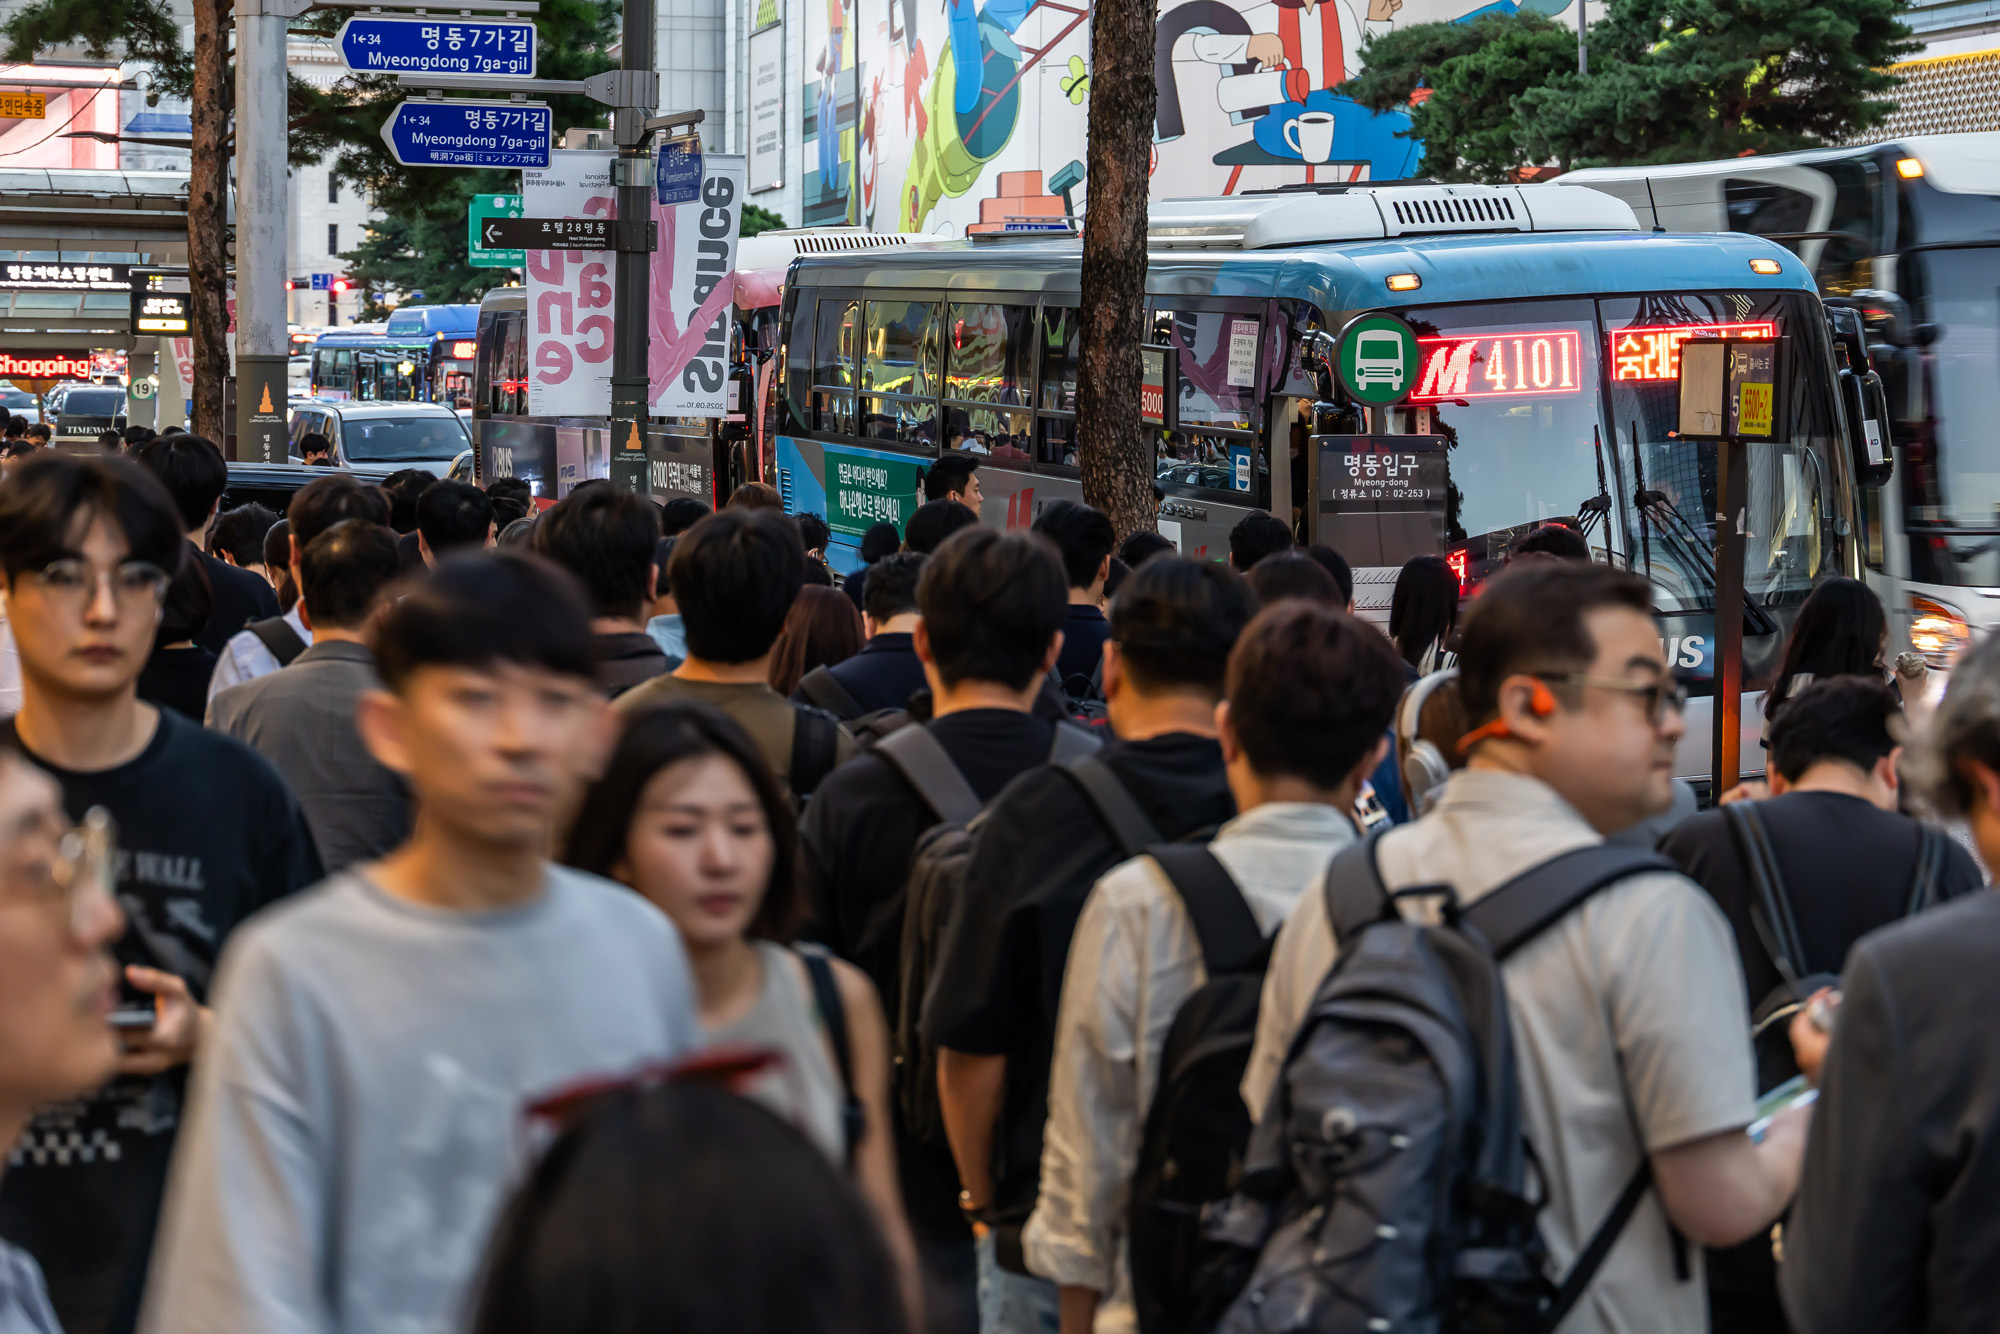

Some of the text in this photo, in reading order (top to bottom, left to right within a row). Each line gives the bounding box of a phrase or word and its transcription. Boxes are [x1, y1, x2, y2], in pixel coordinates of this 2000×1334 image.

[367, 34, 381, 45] 34
[421, 26, 528, 53] 명동7가길
[368, 52, 527, 73] Myeongdong 7ga-gil
[418, 115, 430, 125] 34
[465, 109, 545, 132] 명동7가길
[412, 132, 545, 149] Myeongdong 7ga-gil
[1485, 337, 1574, 391] 4101
[134, 383, 150, 395] 19
[1142, 391, 1164, 415] 5000
[1744, 388, 1768, 420] 5500-2
[66, 426, 120, 434] TIMEWAK
[263, 433, 271, 464] 명동성
[652, 460, 668, 488] 8100
[1343, 453, 1420, 477] 명동입구
[1340, 488, 1367, 499] 정류소
[1371, 489, 1382, 498] ID
[1393, 489, 1423, 498] 02-253
[1353, 478, 1409, 488] Myeong-dong
[1658, 635, 1705, 668] US
